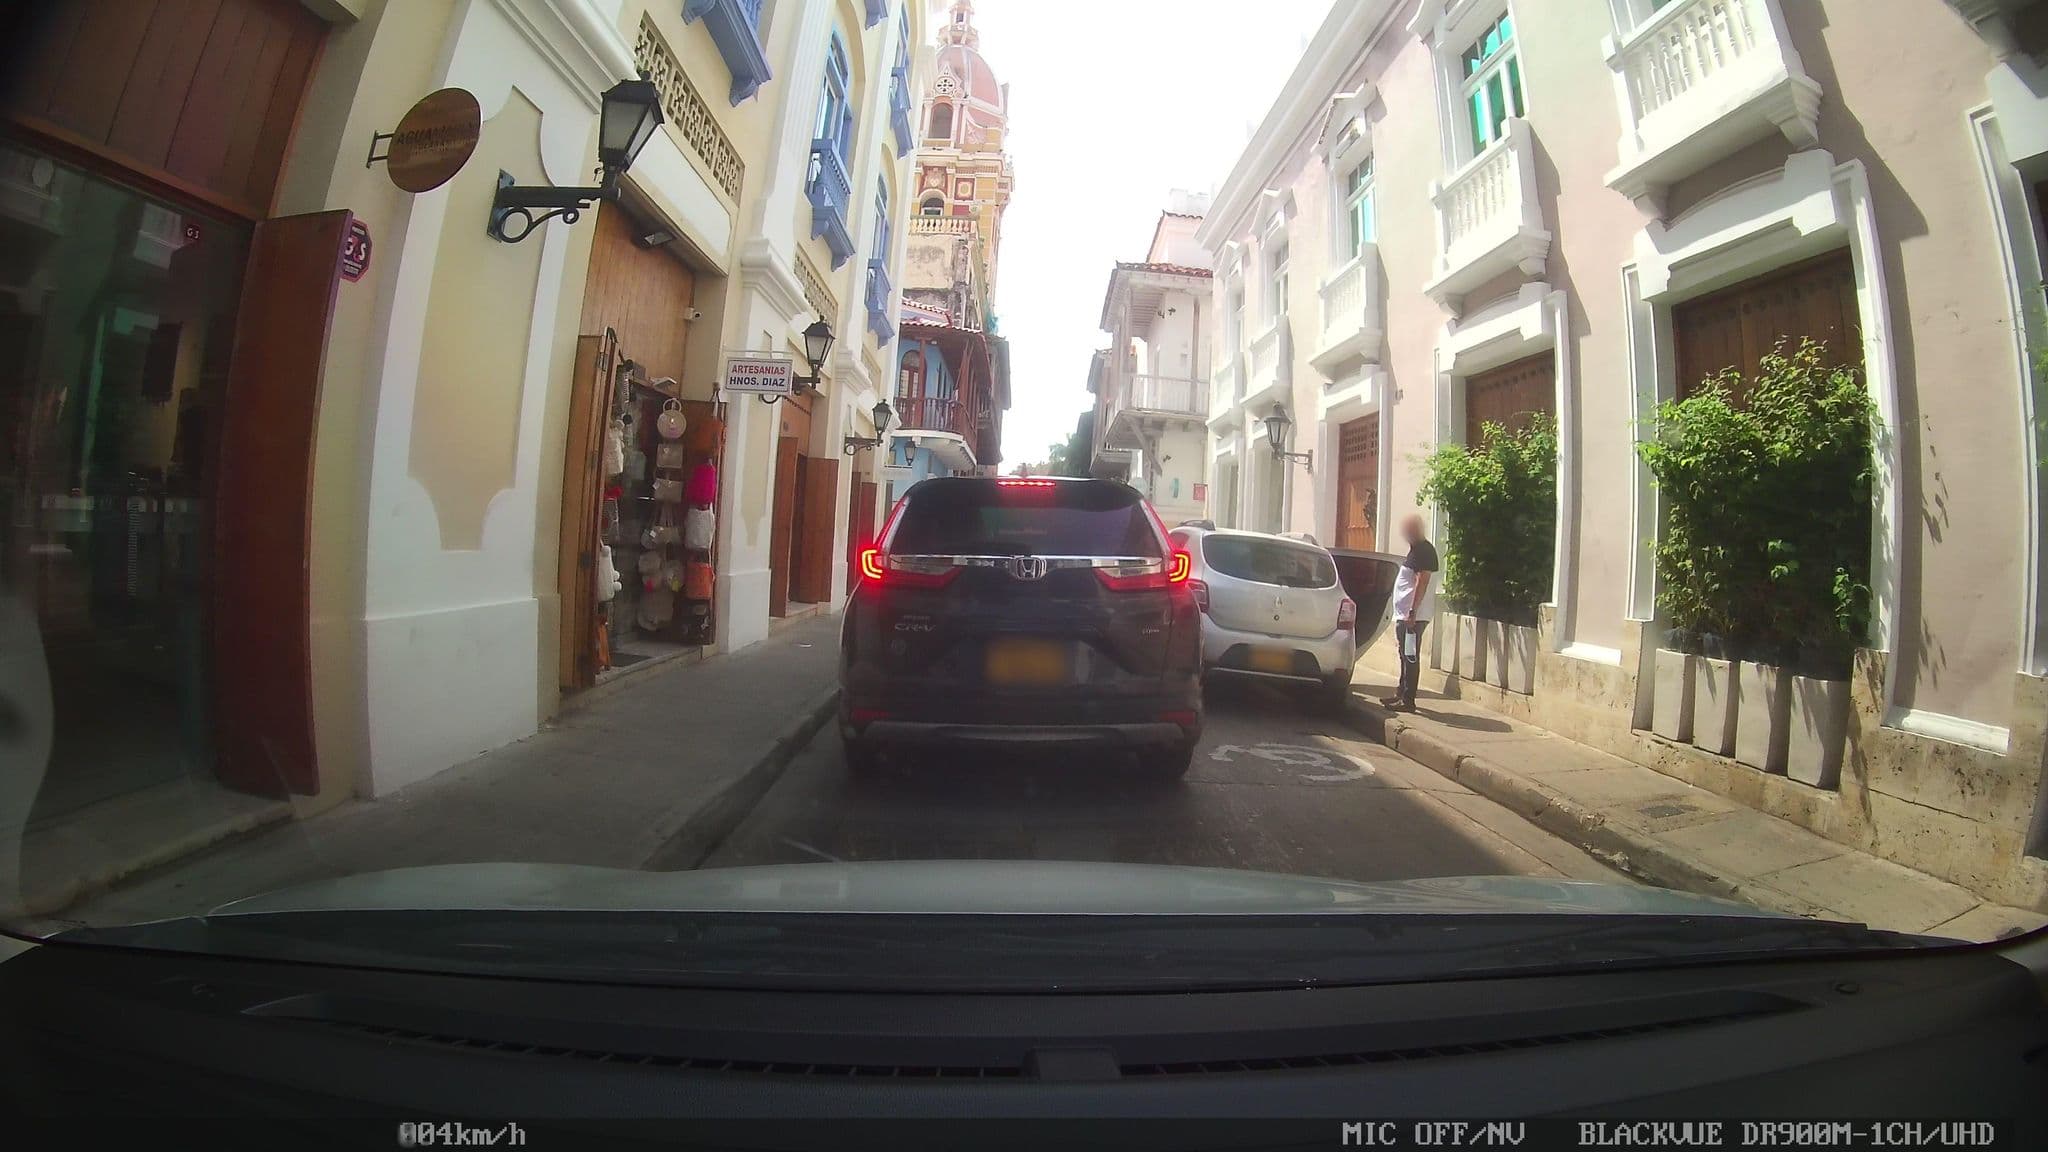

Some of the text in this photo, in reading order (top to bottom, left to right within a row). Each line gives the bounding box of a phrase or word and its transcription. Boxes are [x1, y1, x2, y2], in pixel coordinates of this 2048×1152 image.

[731, 364, 785, 375] ARTESANIAS
[729, 376, 785, 387] HNOS. DIAZ
